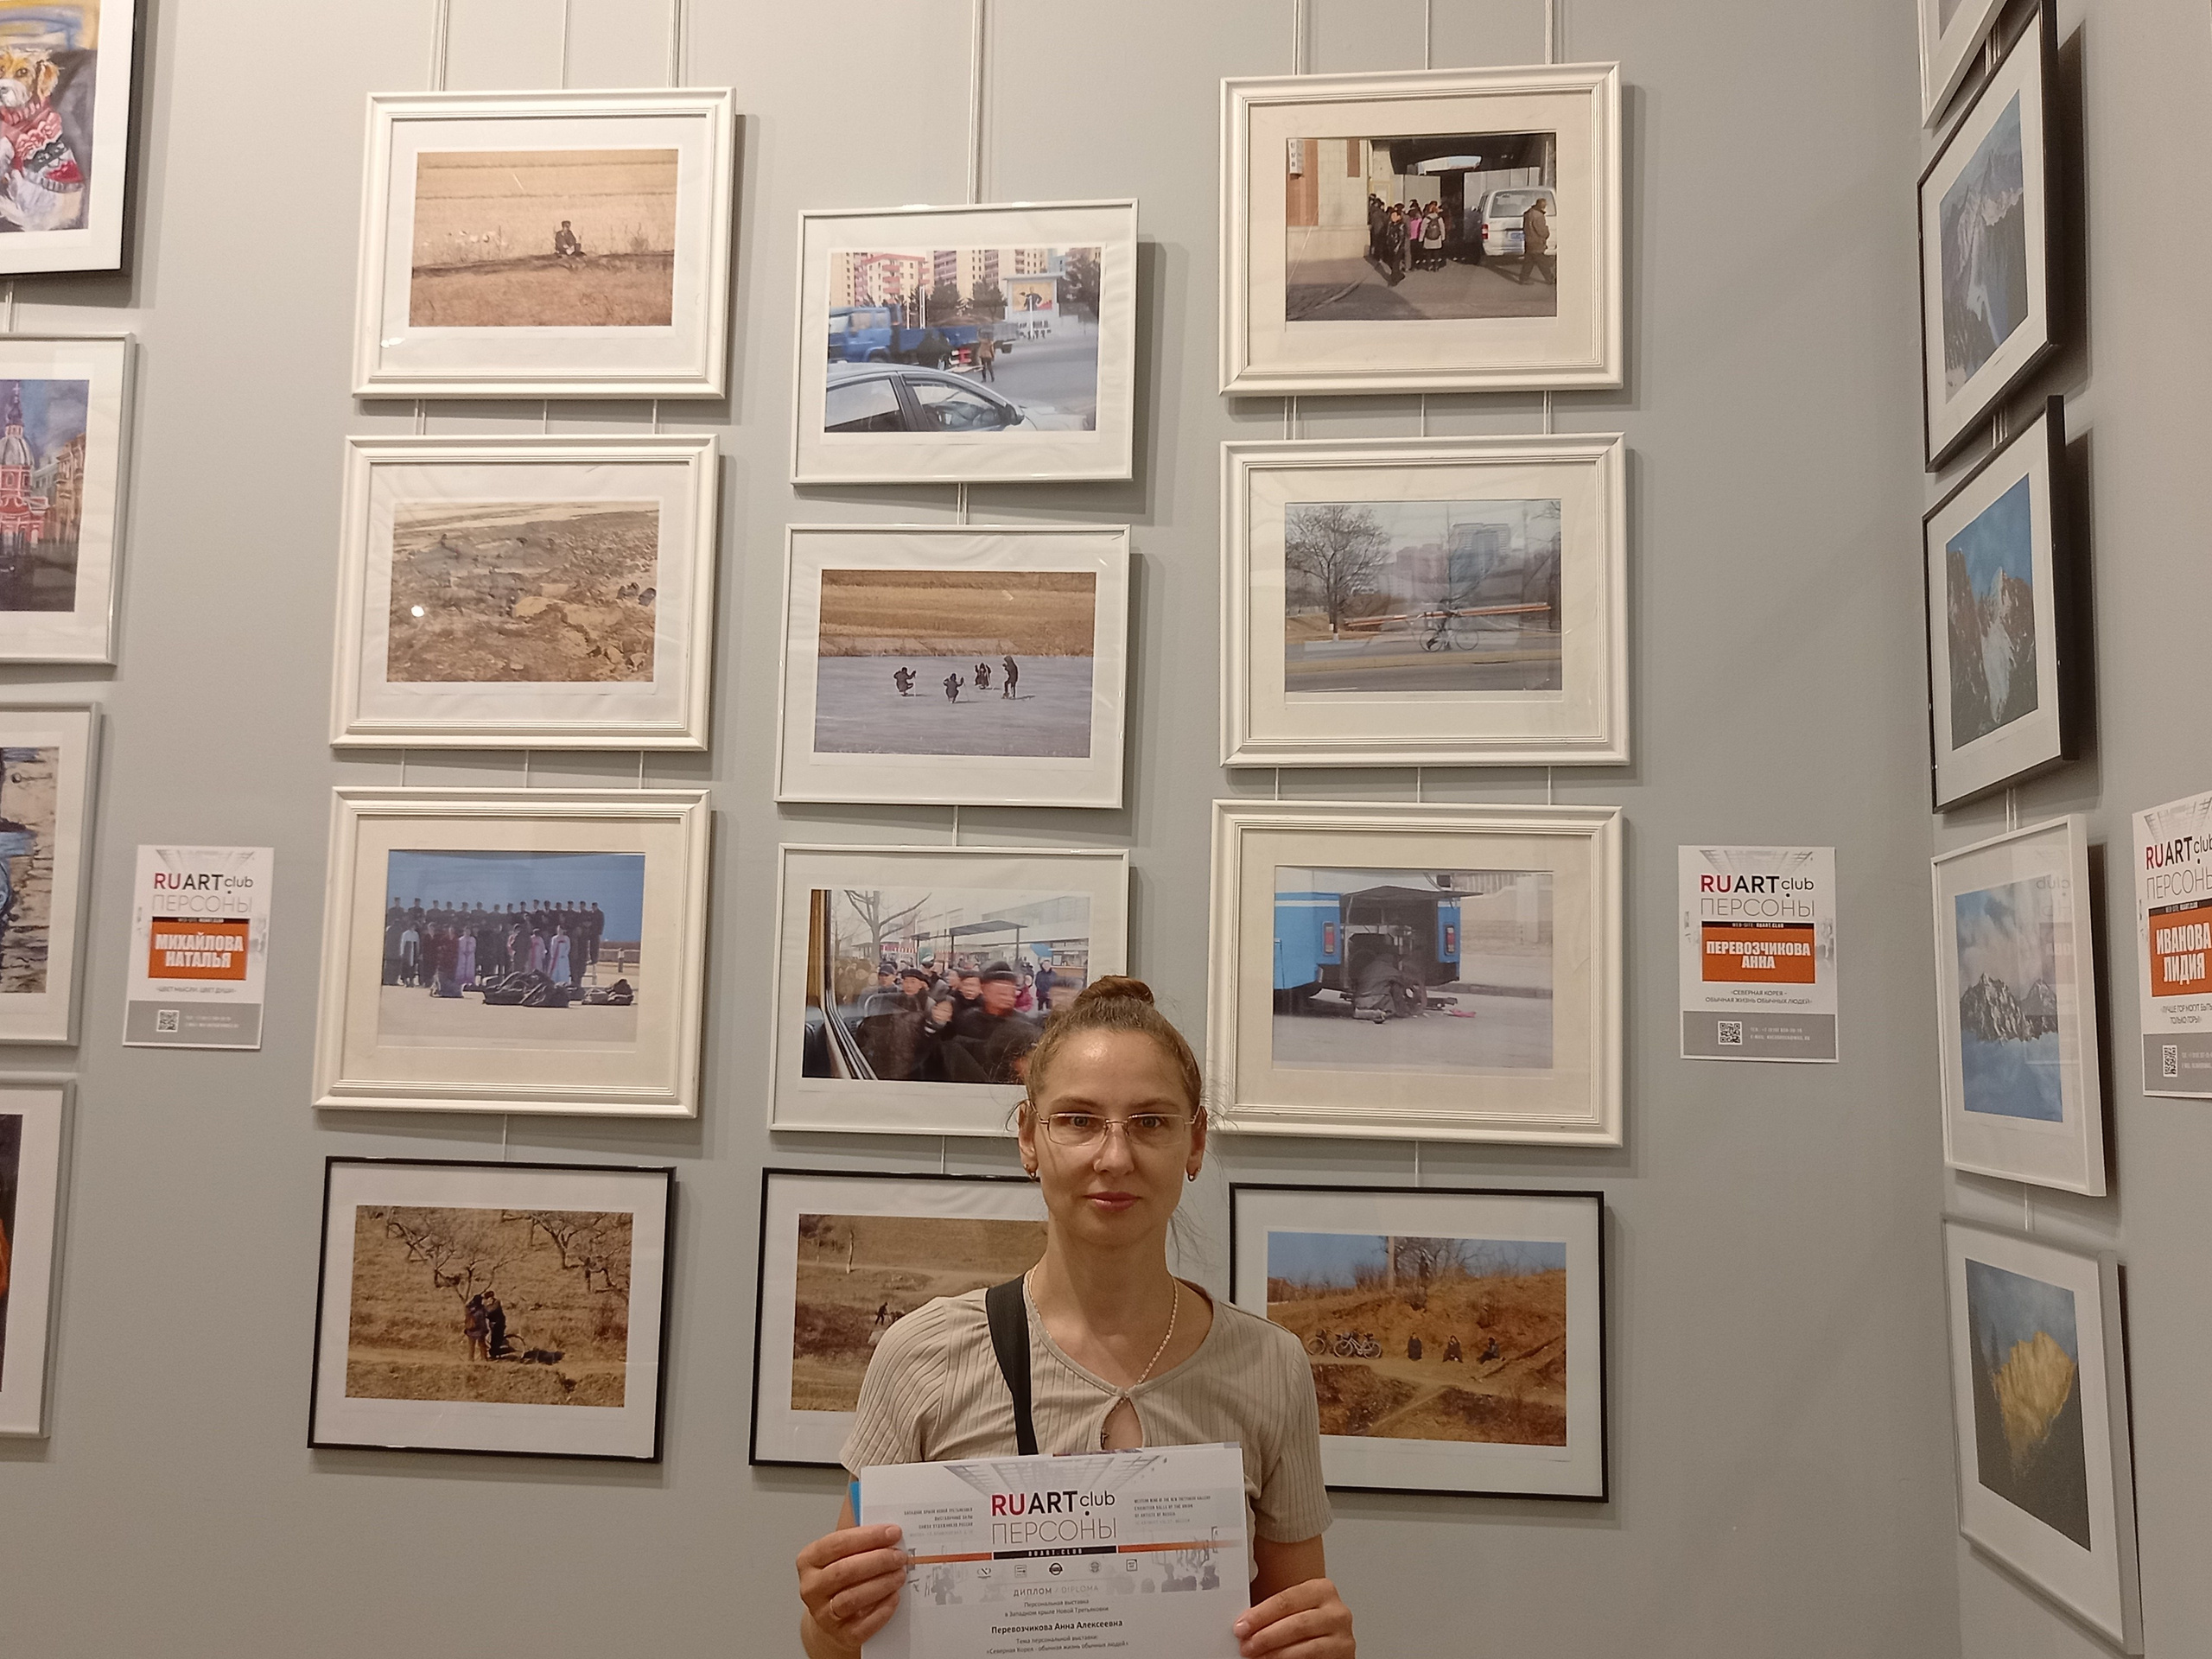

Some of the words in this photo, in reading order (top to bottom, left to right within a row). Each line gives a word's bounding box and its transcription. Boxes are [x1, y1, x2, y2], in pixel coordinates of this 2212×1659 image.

[152, 894, 252, 912] ПЕРСОНЫ
[1700, 898, 1815, 917] ПЕРСОНЫ
[156, 931, 244, 951] МИХАЙЛОВА
[2156, 922, 2212, 955] ИВАНОВА
[1706, 941, 1811, 956] ПЕРЕВОЗЧИКОВА
[165, 951, 232, 968] НАТАЛЬЯ
[1741, 956, 1776, 969] АННА
[2164, 952, 2206, 985] ЛИДИЯ
[992, 1517, 1116, 1544] ПЕРСОНЫ
[1014, 1587, 1052, 1597] ДИПЛОМ
[1061, 1585, 1099, 1594] DIPLOMA
[991, 1624, 1053, 1635] Перевозчикова
[1054, 1622, 1075, 1631] Анна
[1076, 1619, 1123, 1630] Алексеевна
